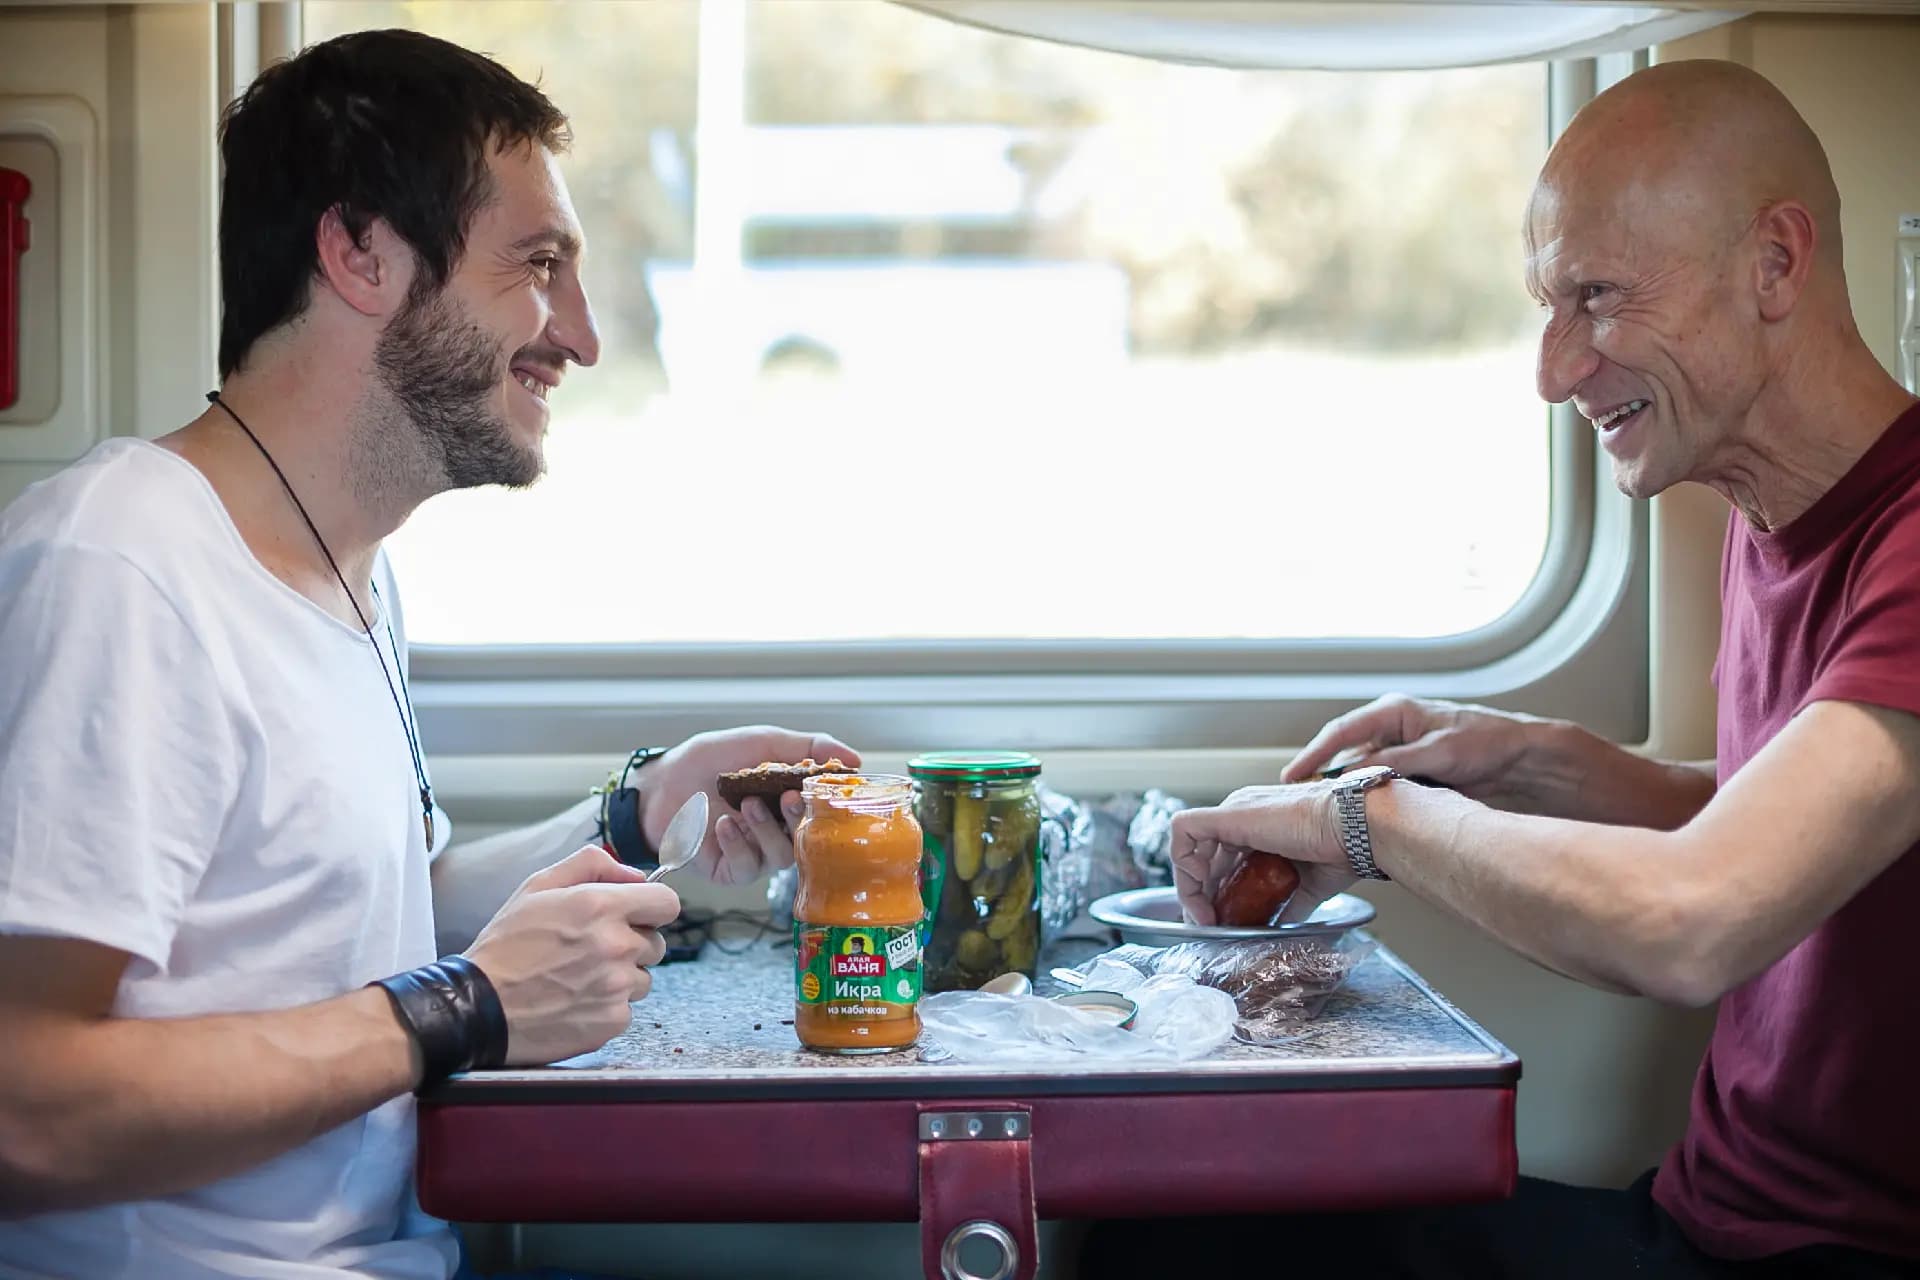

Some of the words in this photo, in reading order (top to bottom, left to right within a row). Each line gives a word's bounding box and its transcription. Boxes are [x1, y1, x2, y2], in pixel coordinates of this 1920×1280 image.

[889, 934, 914, 954] ГОСТ
[838, 962, 880, 973] ВАНЯ
[835, 981, 882, 1001] Икра
[828, 1006, 840, 1015] из
[841, 1004, 887, 1015] кабачков
